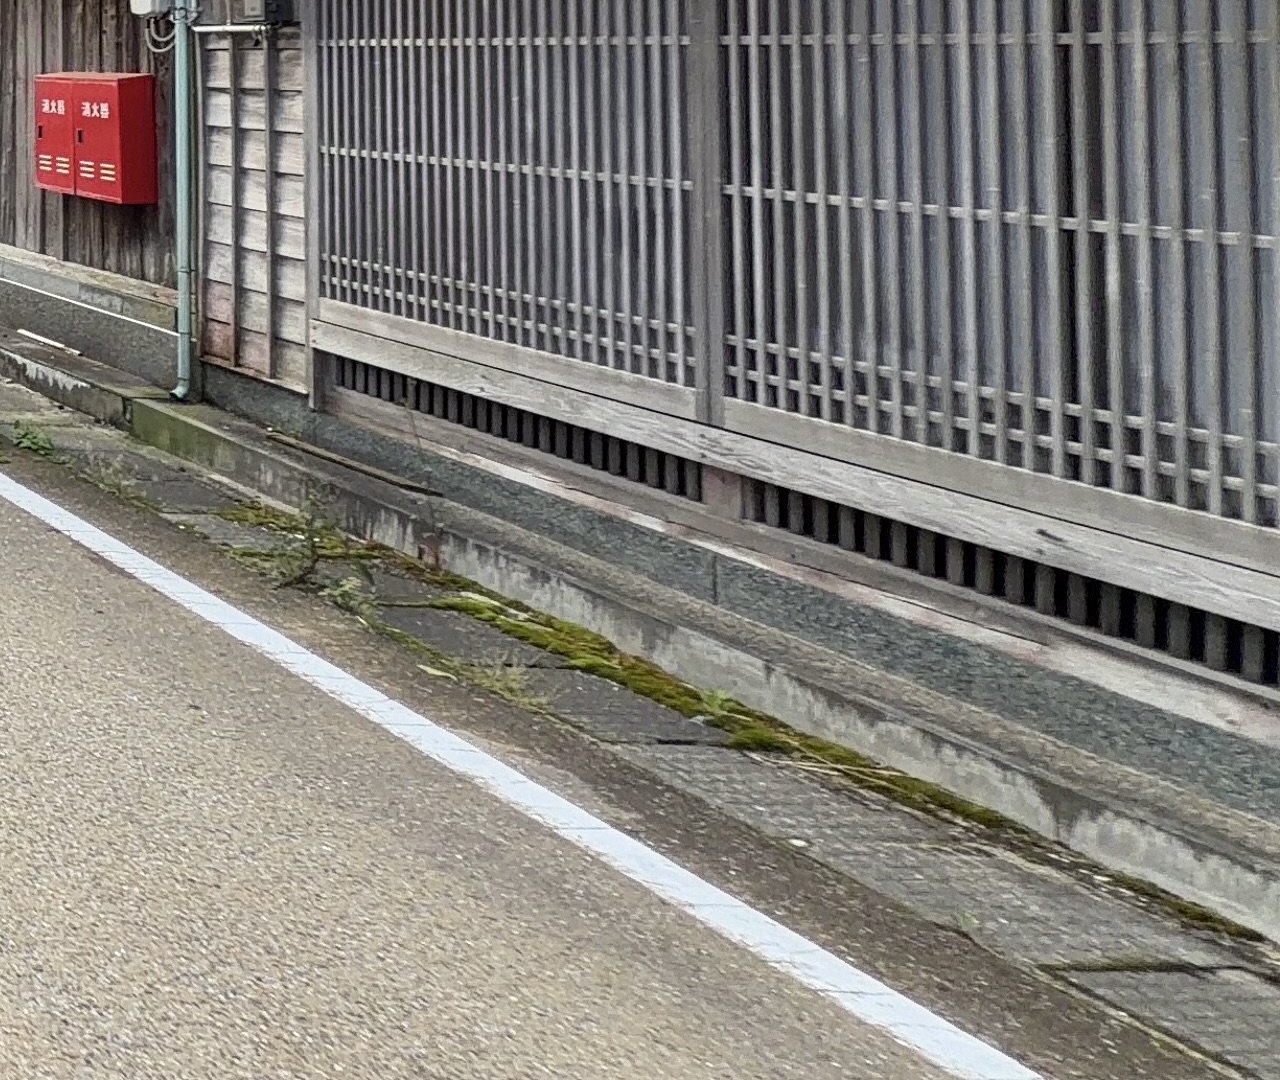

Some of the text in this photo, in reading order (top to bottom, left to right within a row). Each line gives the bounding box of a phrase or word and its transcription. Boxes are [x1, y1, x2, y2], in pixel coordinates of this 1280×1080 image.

[41, 99, 65, 115] 消火器
[81, 101, 109, 119] 消火器
